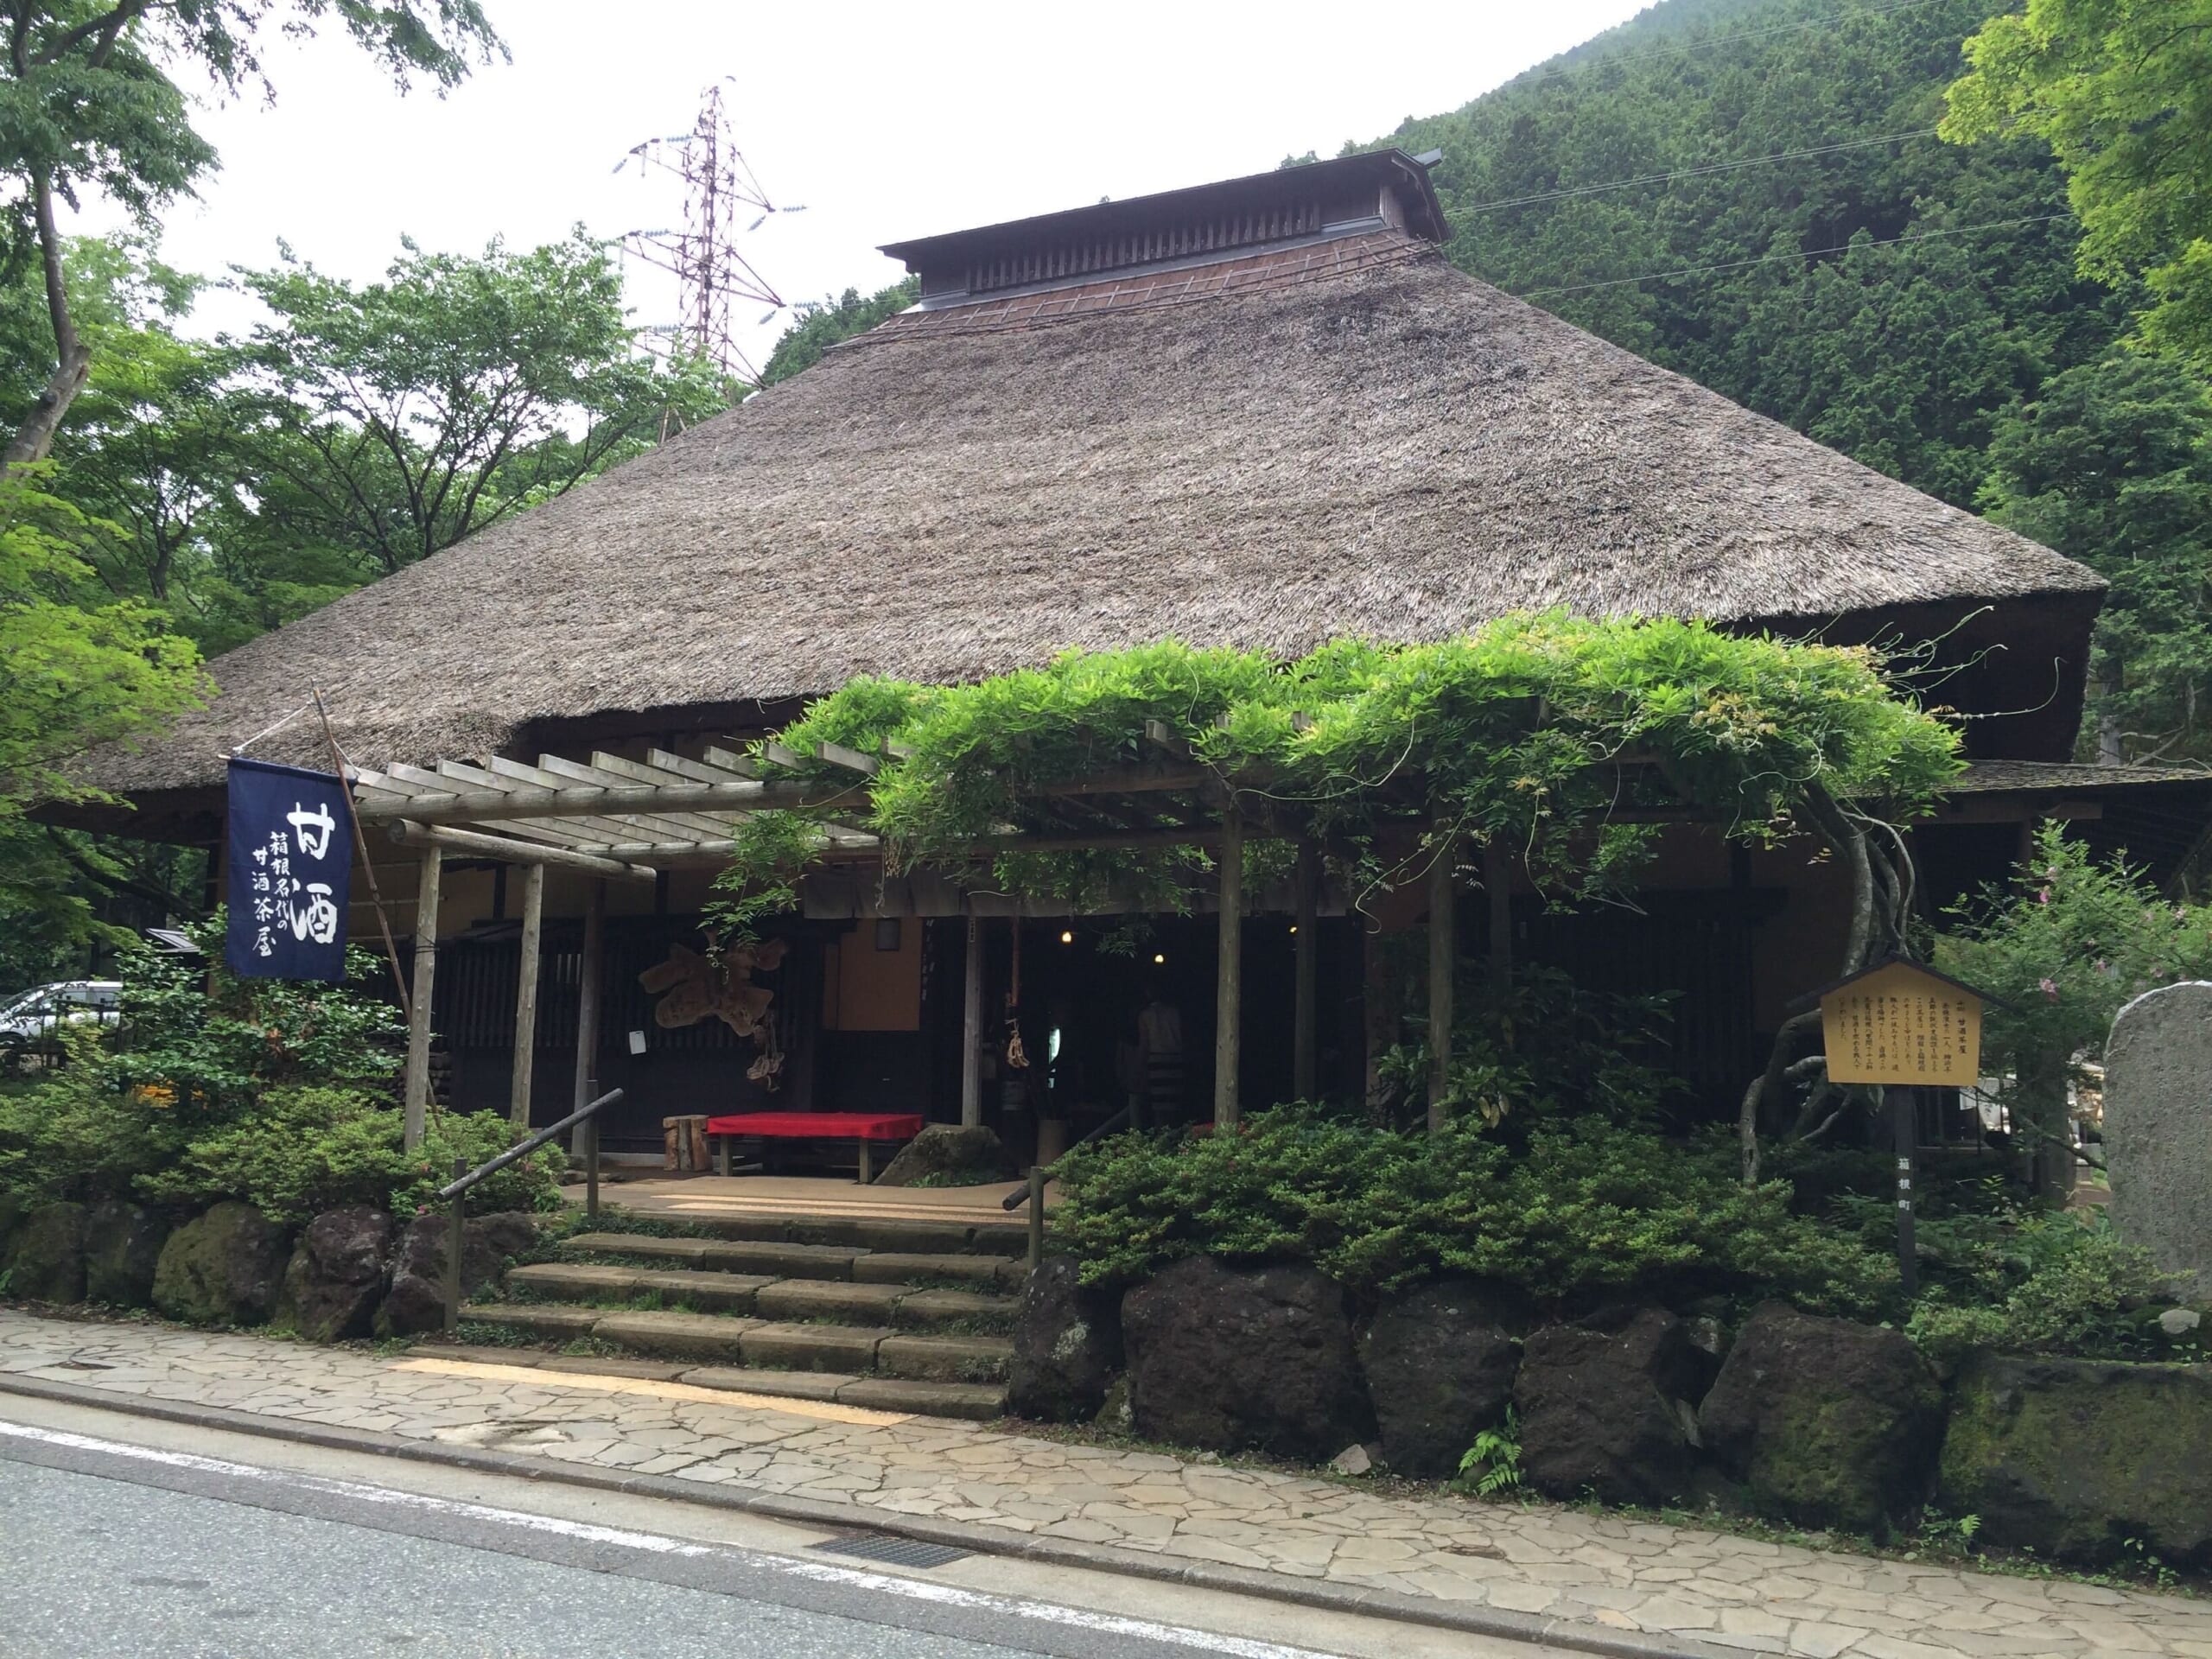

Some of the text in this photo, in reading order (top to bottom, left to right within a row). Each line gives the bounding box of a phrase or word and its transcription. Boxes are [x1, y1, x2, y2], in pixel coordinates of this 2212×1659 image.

[252, 846, 276, 957] 甘酒茶屋
[270, 831, 290, 931] 箱根名代の
[286, 802, 338, 945] 甘酒
